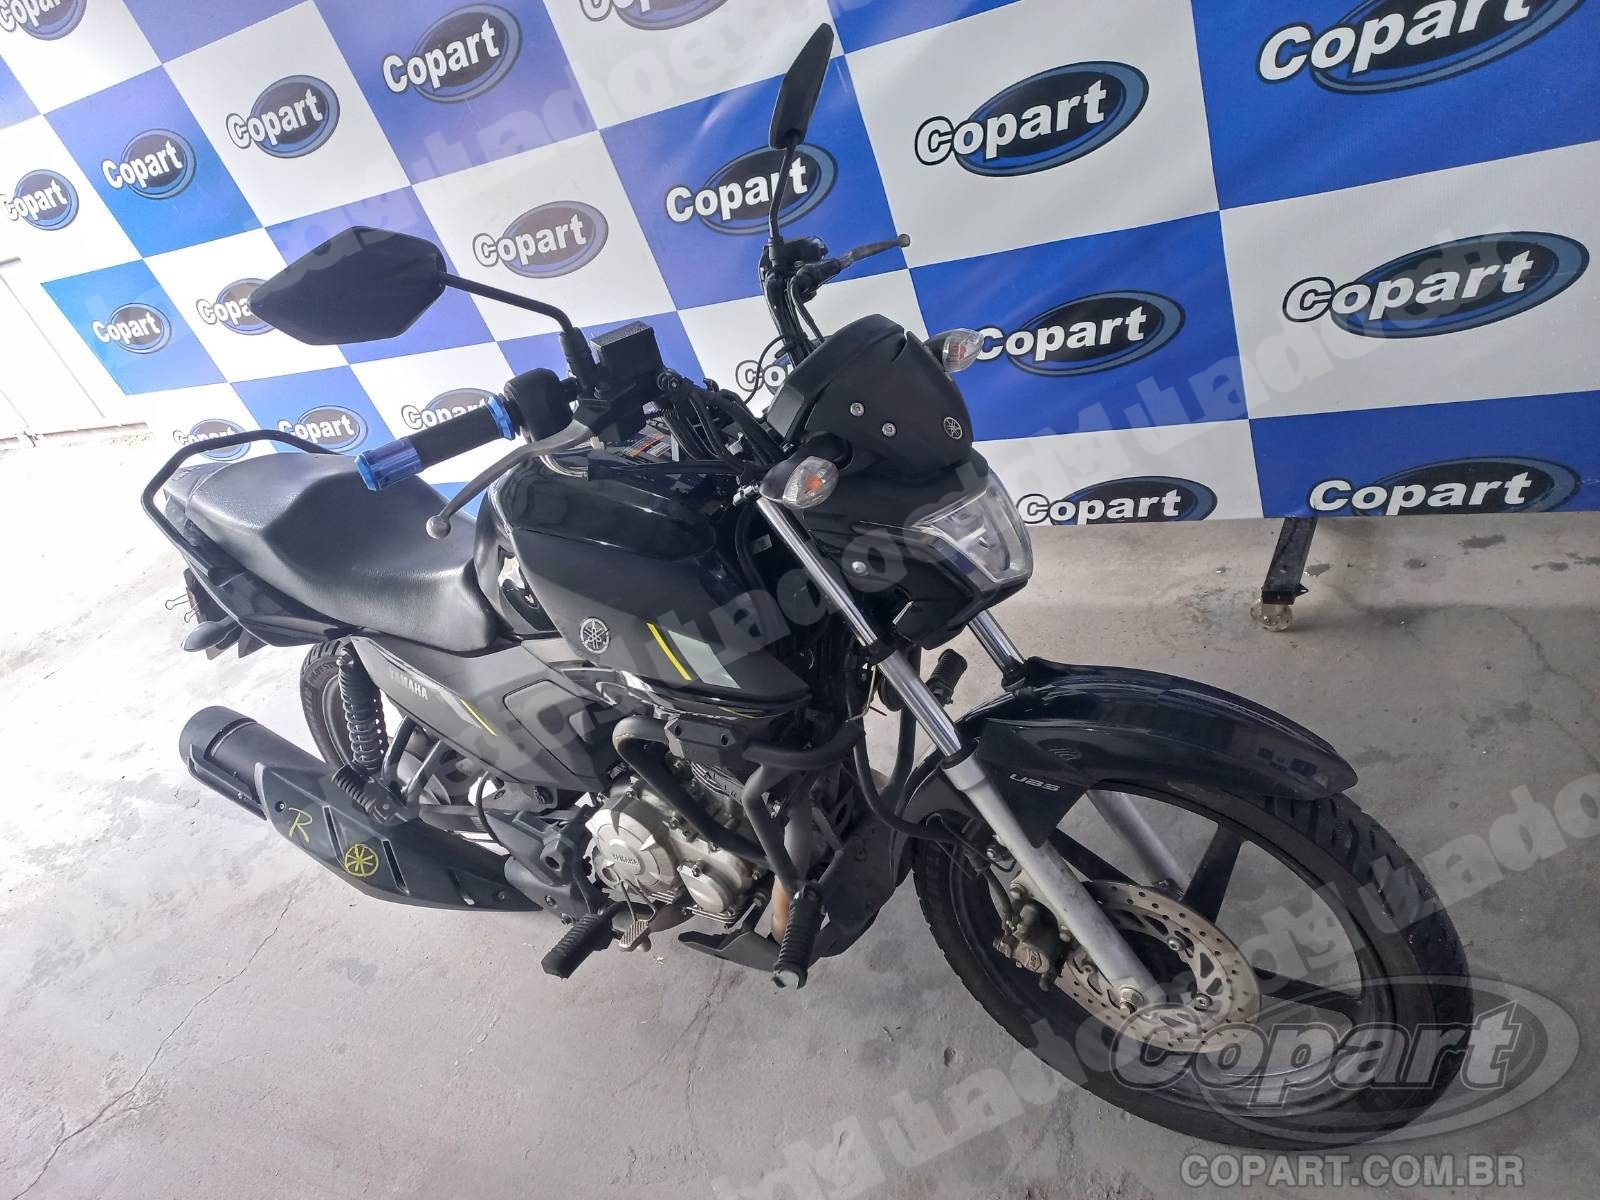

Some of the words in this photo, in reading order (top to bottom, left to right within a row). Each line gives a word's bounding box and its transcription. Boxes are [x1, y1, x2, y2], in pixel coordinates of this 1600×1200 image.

[381, 17, 500, 94] Copart
[225, 88, 323, 149] Copart
[914, 79, 1108, 166] Copart
[102, 140, 183, 189] Copart
[473, 214, 587, 267] Copart
[196, 298, 252, 325] Copa
[1283, 251, 1535, 323] Copart
[92, 311, 161, 345] Copart
[974, 306, 1147, 361] Copart
[1017, 489, 1181, 525] Copart
[1309, 472, 1532, 516] Copart
[289, 807, 313, 843] R
